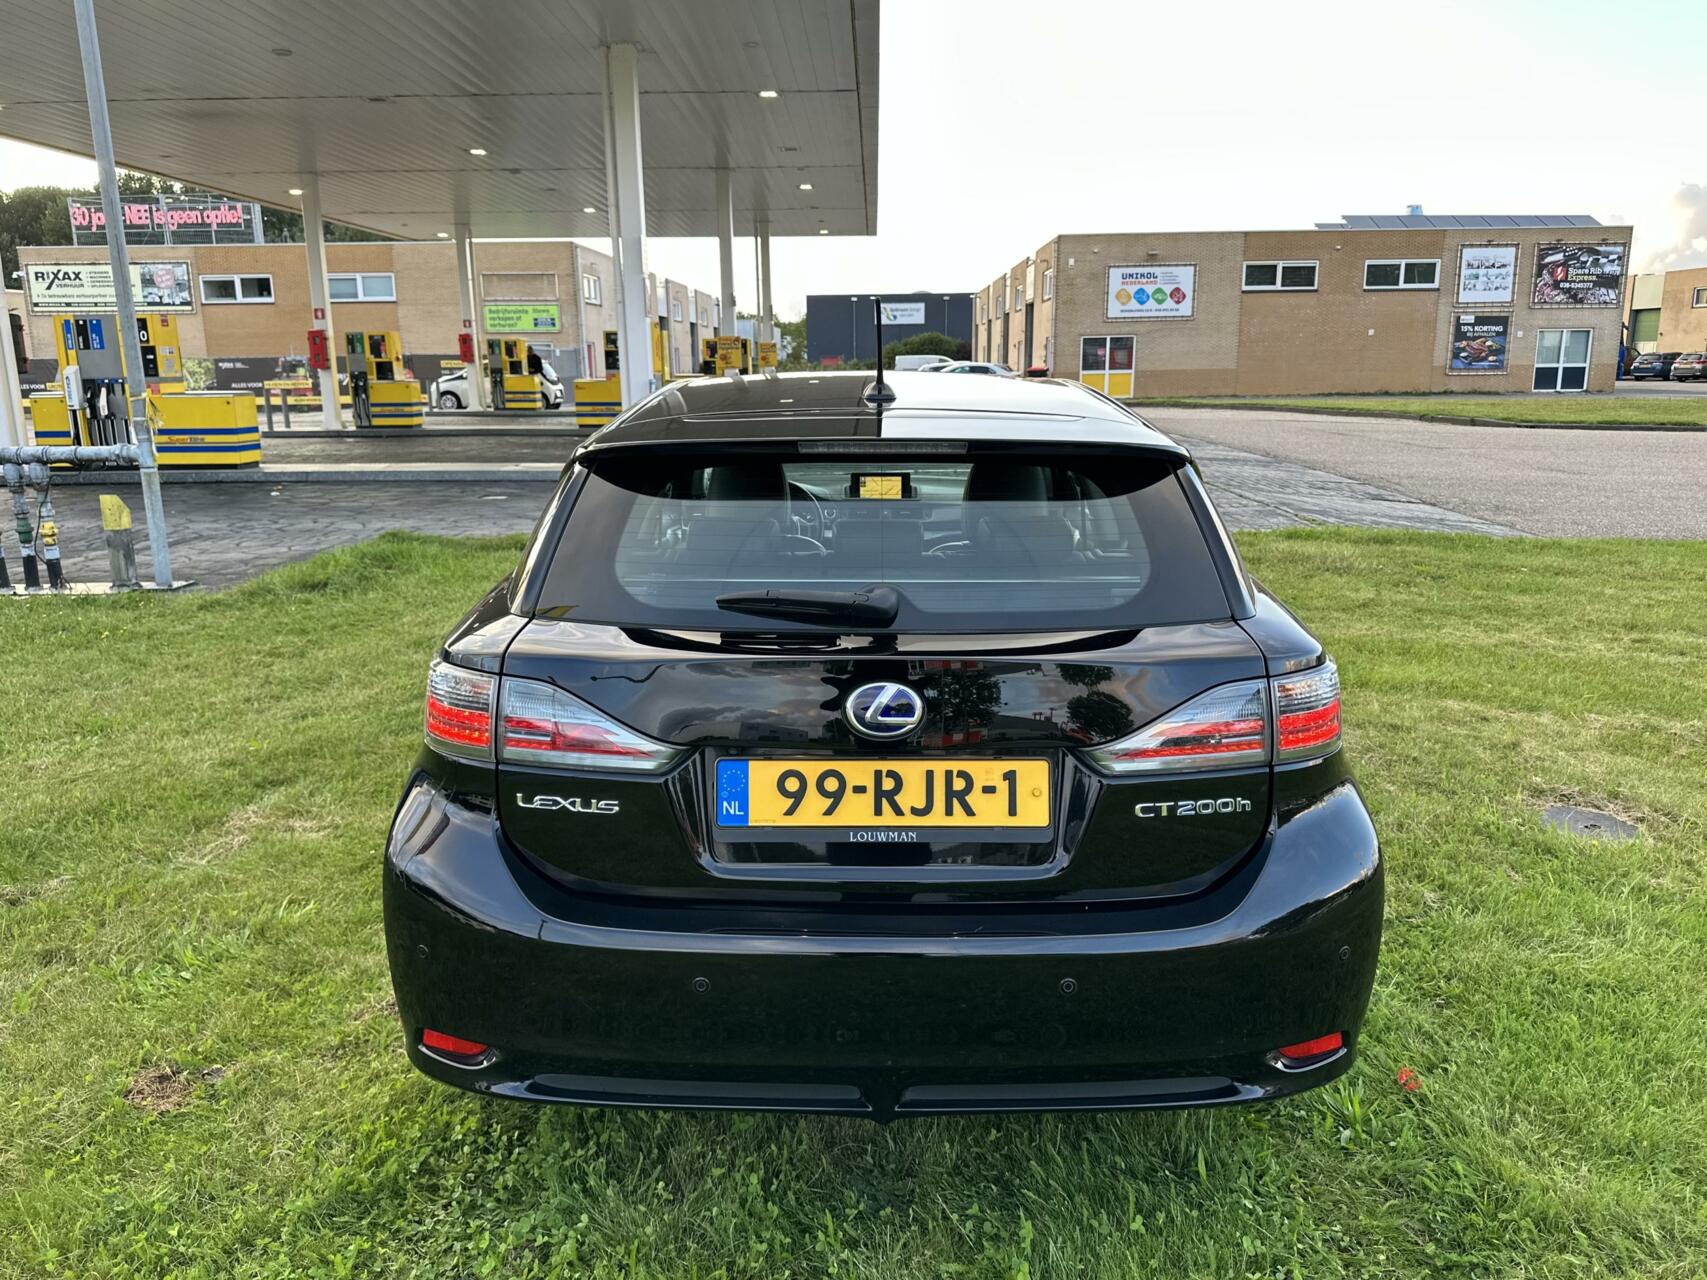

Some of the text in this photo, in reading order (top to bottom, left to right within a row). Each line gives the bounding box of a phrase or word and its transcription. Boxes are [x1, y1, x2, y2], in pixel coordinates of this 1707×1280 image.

[71, 207, 89, 225] 30
[125, 205, 150, 225] NEE
[153, 207, 165, 225] is
[167, 209, 200, 230] geen
[1121, 272, 1158, 280] UNIKOL
[1568, 267, 1589, 275] Spare
[776, 769, 1018, 816] 99-RJR-1
[516, 793, 619, 814] LEXUS
[722, 801, 744, 815] NL
[849, 831, 917, 842] LOUWMAN
